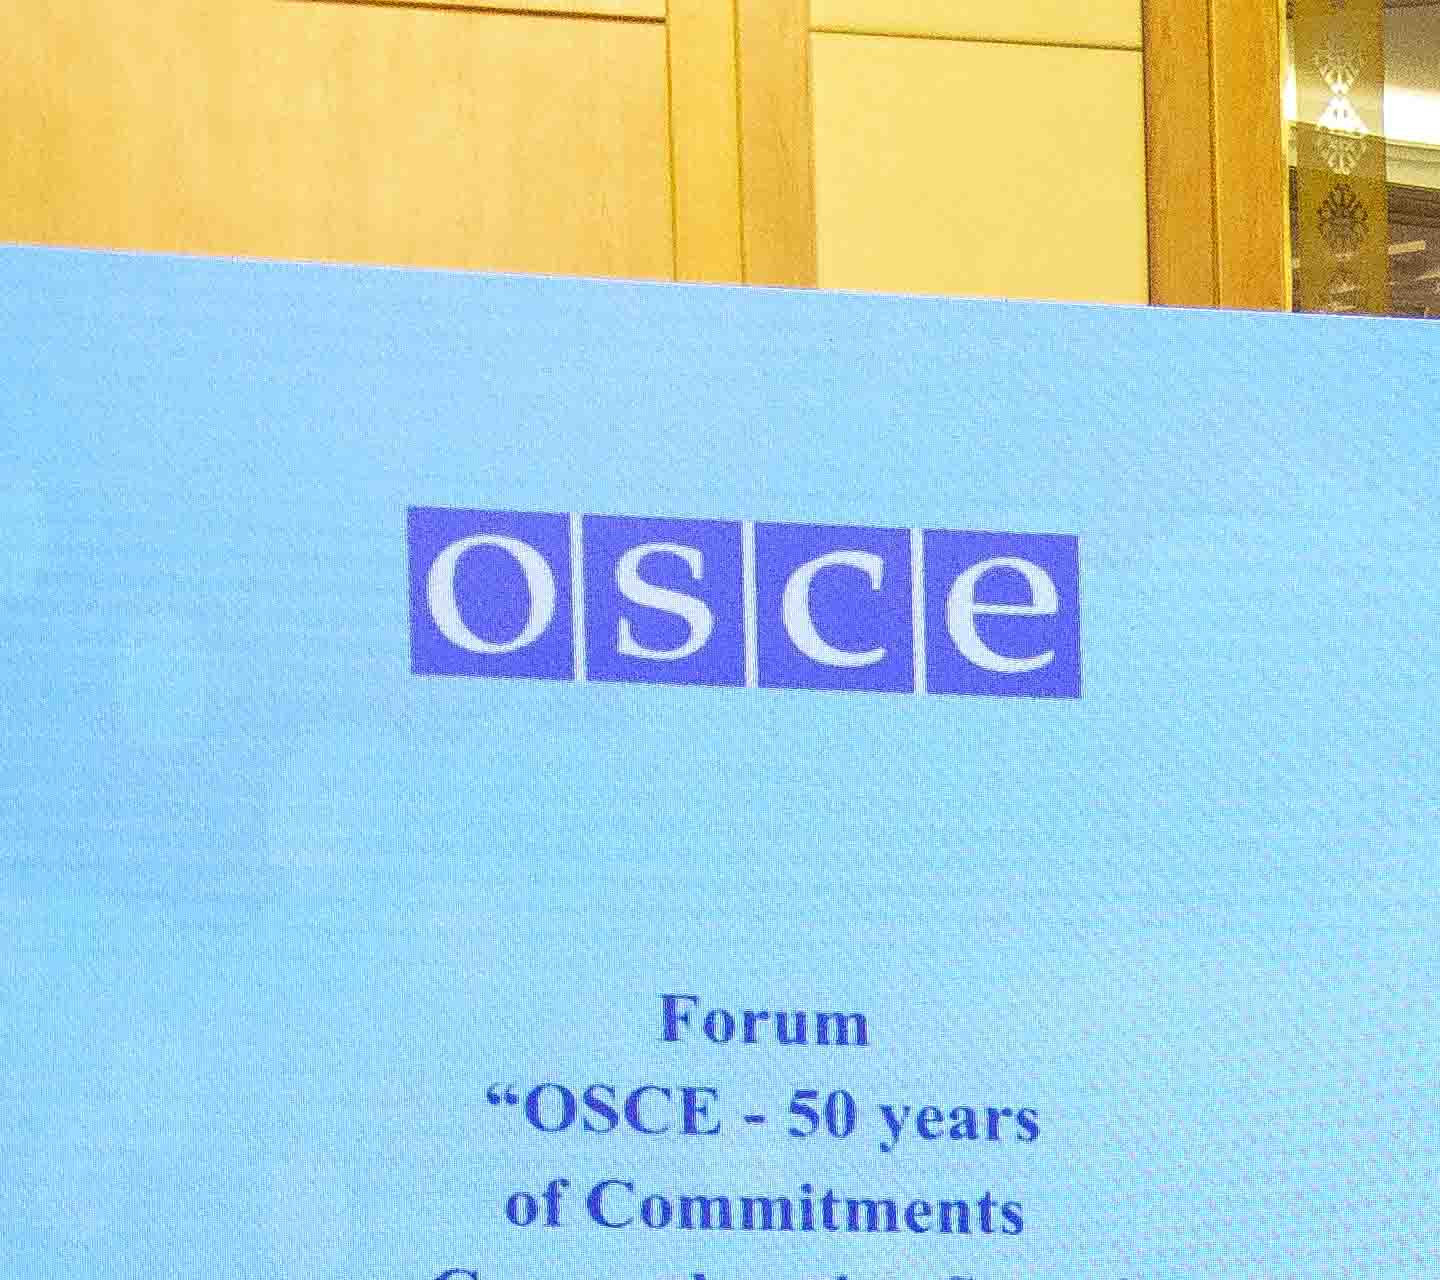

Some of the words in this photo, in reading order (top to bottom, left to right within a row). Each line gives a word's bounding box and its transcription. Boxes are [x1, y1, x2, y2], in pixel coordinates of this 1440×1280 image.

[661, 994, 867, 1046] Forum
[789, 1089, 856, 1138] 50
[879, 1105, 1039, 1153] years
[505, 1178, 570, 1227] of
[585, 1179, 1024, 1235] Commitments
